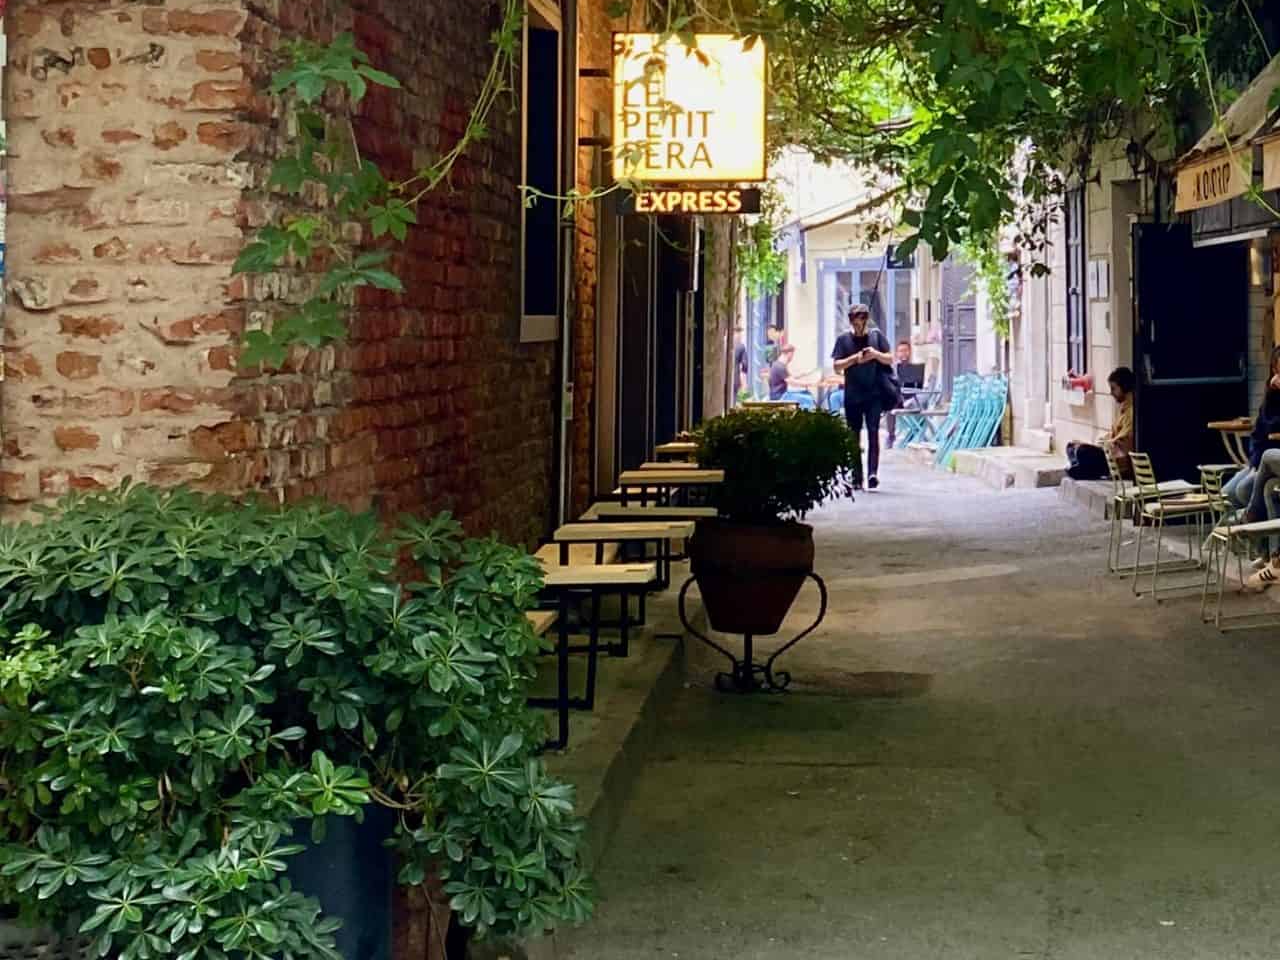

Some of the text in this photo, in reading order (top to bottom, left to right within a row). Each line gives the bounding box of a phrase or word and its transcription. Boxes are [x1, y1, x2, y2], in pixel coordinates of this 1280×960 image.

[624, 78, 661, 107] LE
[623, 110, 714, 138] PETIT
[635, 190, 742, 213] EXPRESS
